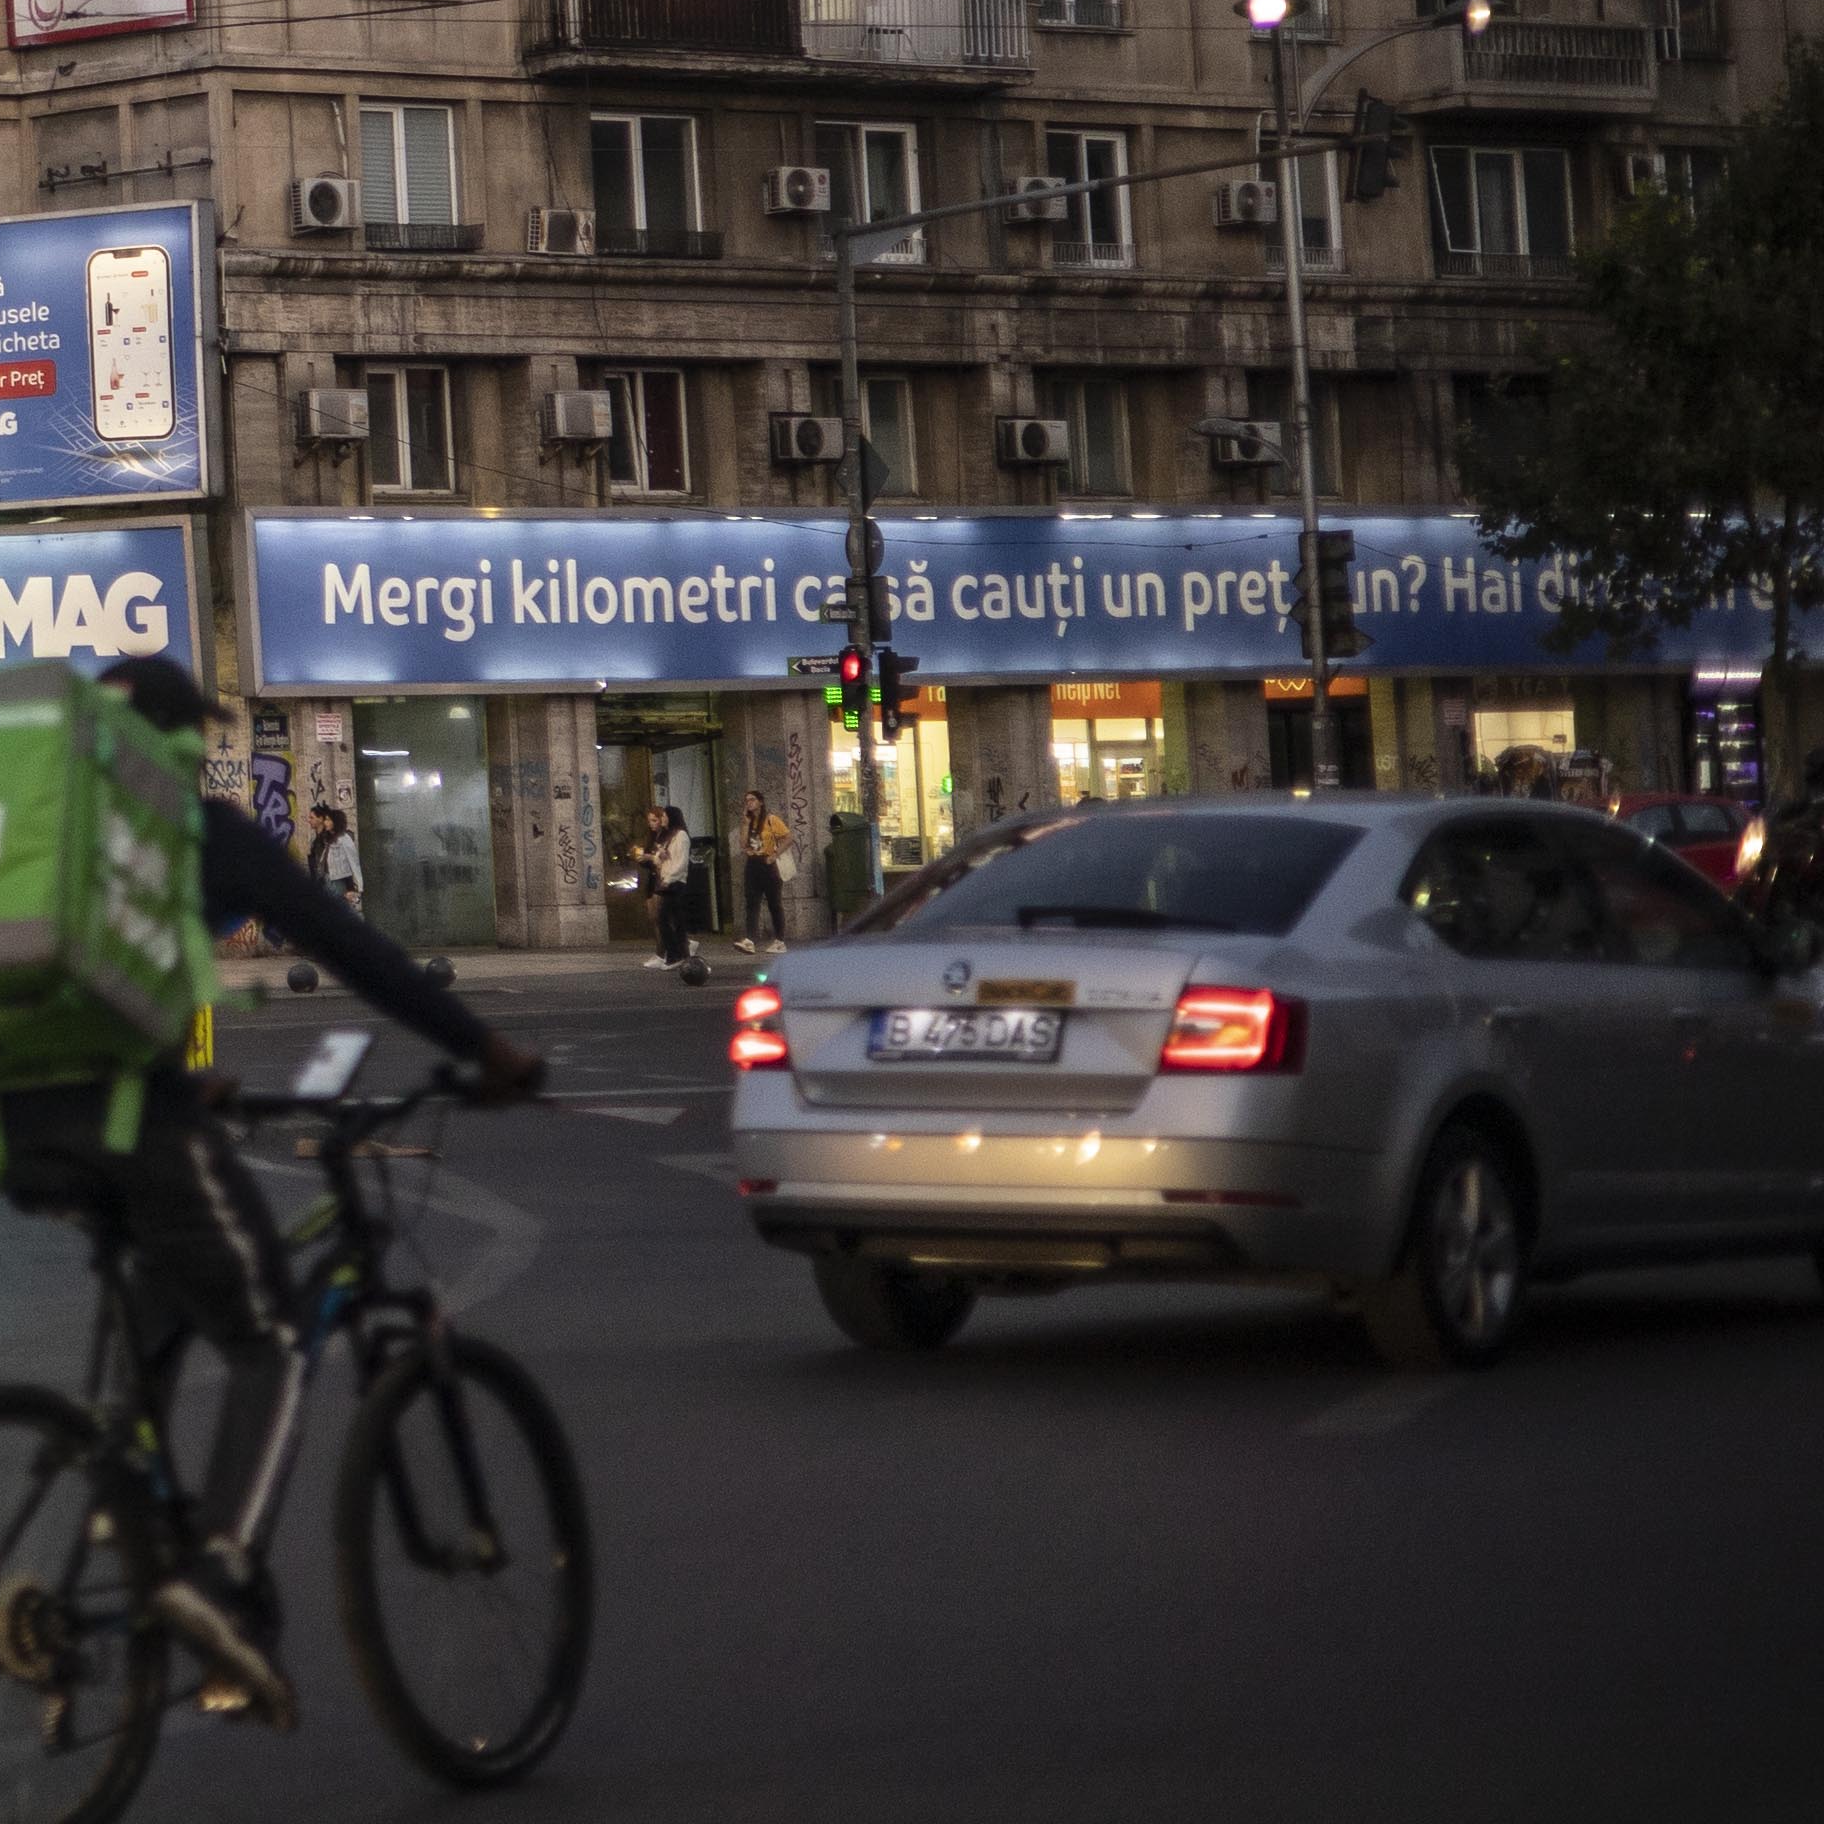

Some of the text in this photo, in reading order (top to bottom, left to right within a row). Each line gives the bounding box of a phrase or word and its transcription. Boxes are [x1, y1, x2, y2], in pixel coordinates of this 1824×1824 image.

[10, 370, 45, 390] Preț
[322, 558, 494, 642] Mergi
[512, 558, 777, 625] kilometri
[951, 557, 1086, 637] cauți
[1104, 569, 1166, 619] un
[1184, 558, 1290, 634] preț
[1444, 556, 1522, 615] Hai
[887, 1015, 910, 1048] B
[986, 1015, 1052, 1049] DAS
